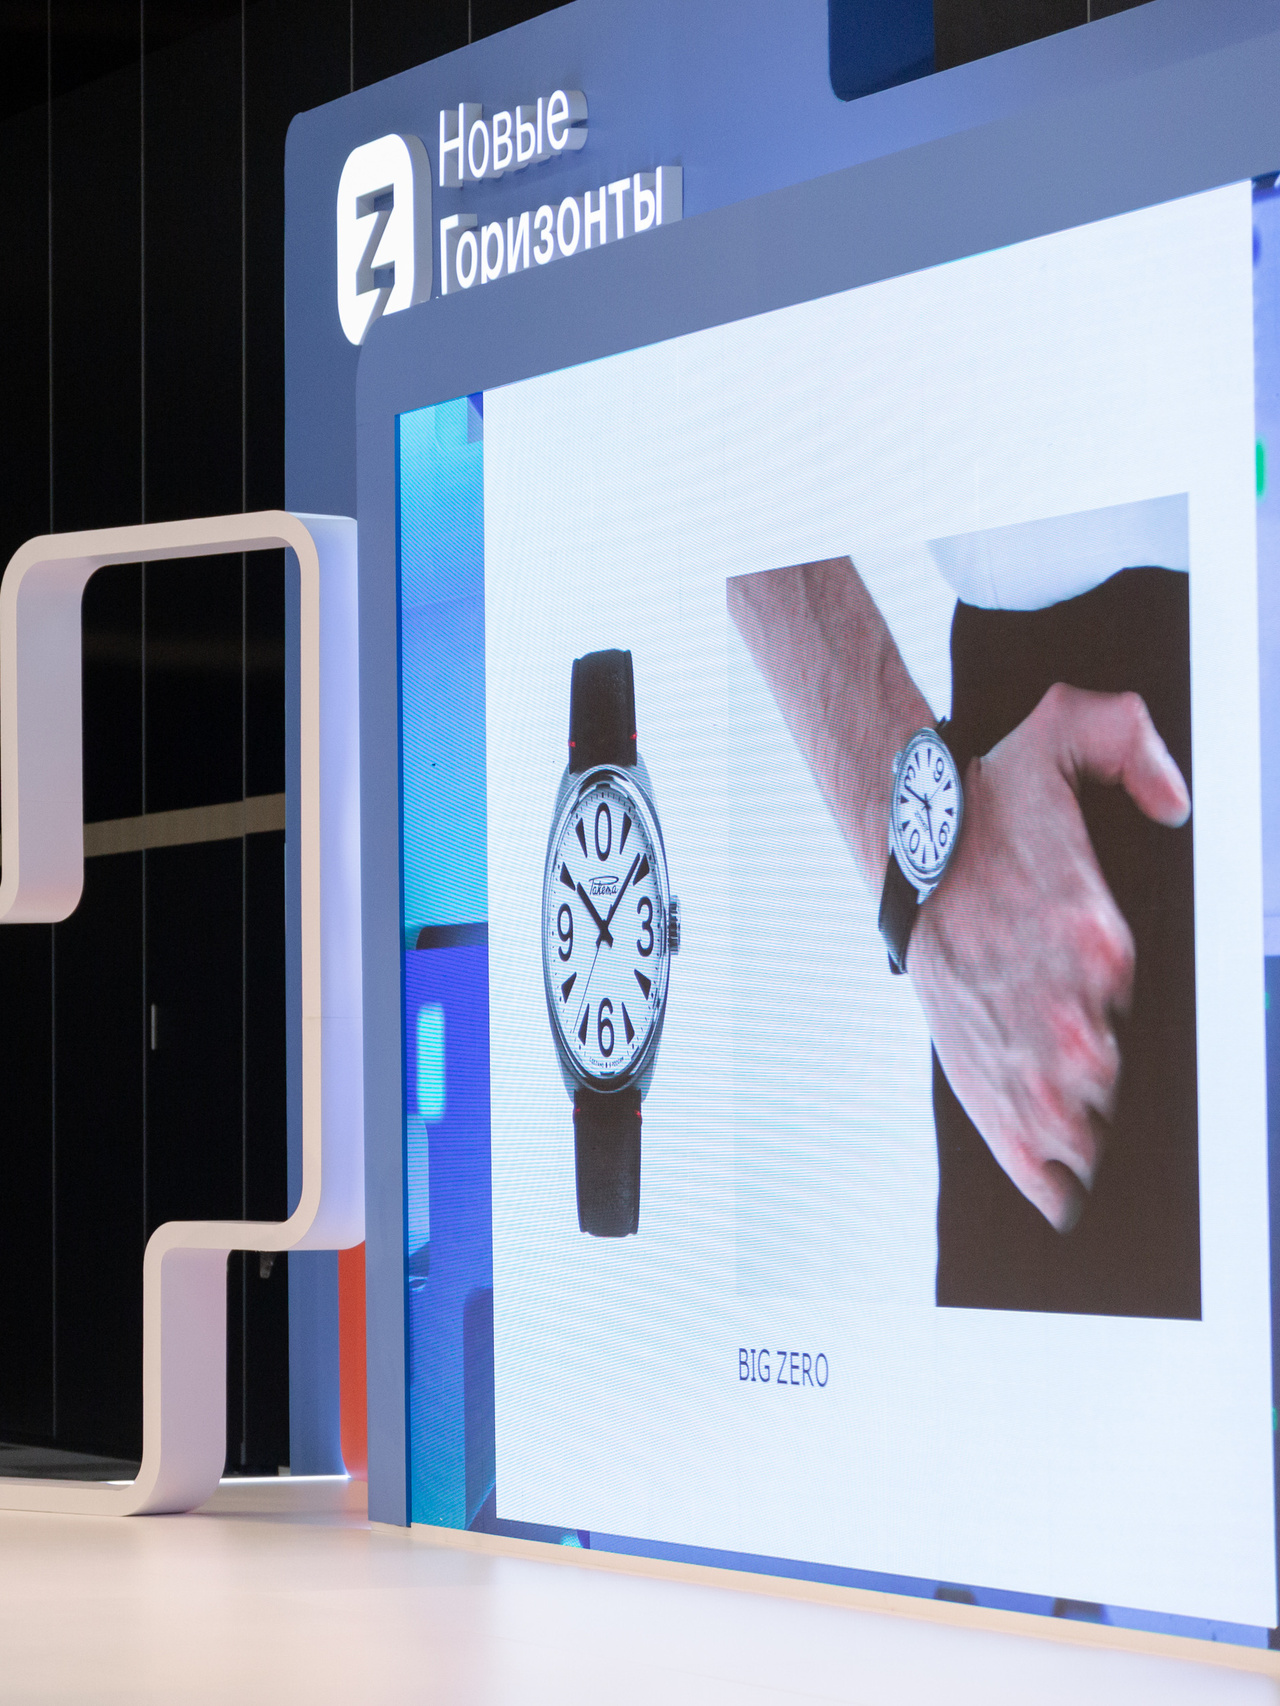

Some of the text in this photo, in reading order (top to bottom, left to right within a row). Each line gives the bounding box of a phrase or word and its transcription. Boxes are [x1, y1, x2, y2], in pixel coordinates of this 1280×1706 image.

[439, 89, 572, 187] Новые
[440, 166, 666, 295] Горизонты
[594, 802, 612, 861] 0
[557, 903, 573, 962] 9
[636, 896, 654, 957] 3
[597, 997, 614, 1057] 6
[738, 1347, 829, 1388] BIG ZERO
